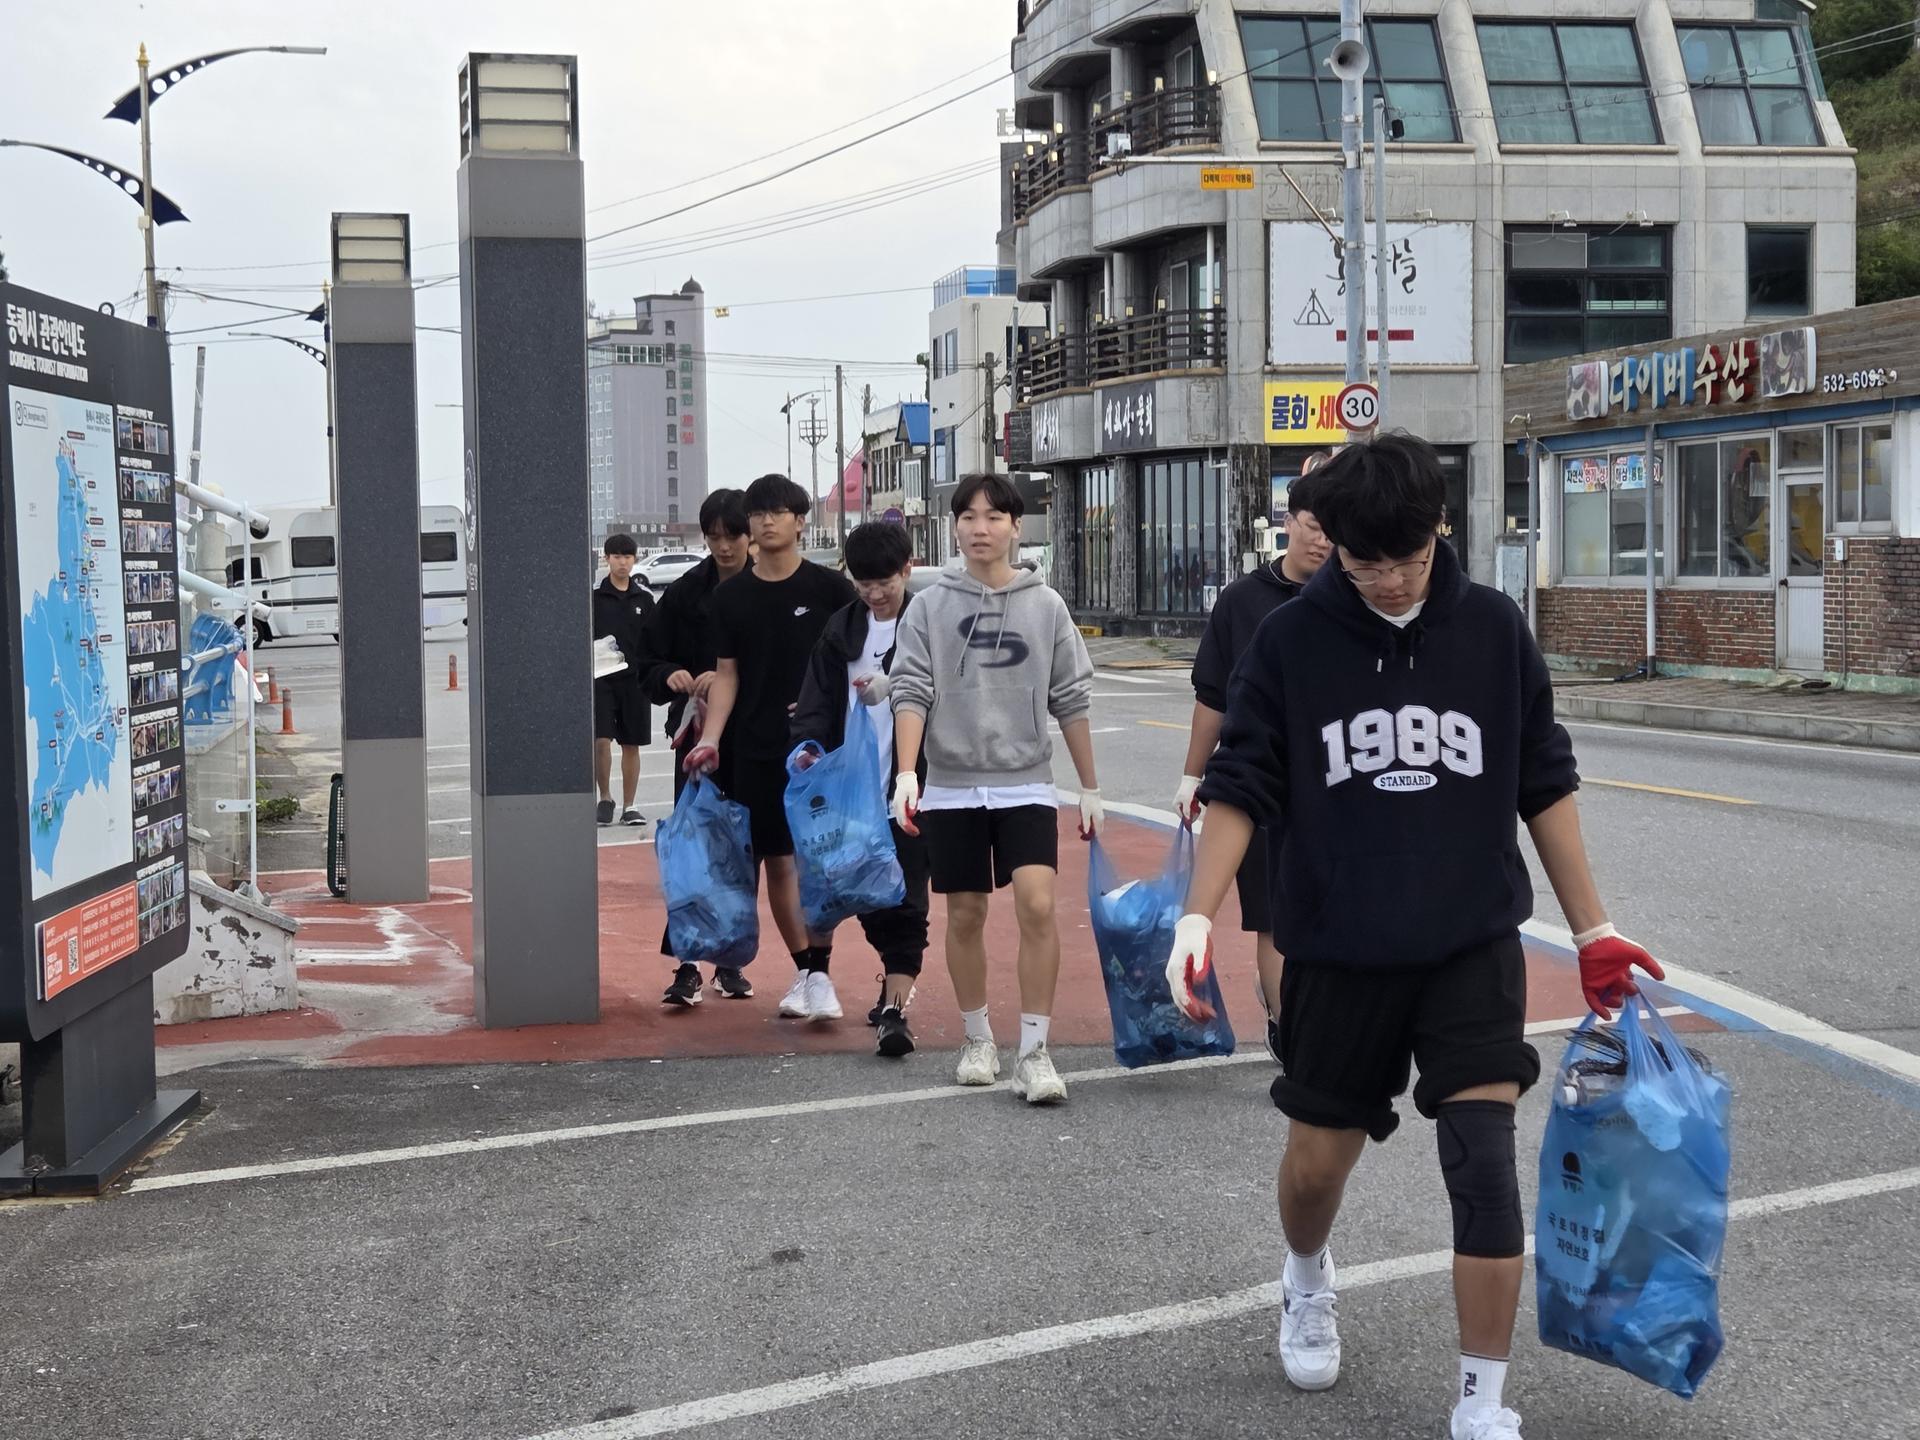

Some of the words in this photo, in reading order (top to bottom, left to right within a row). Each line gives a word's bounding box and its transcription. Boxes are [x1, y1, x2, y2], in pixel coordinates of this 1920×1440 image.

[6, 303, 38, 348] 동해시
[39, 313, 87, 358] 관광안내도
[36, 356, 57, 376] TOURIST
[1346, 397, 1374, 419] 30
[1321, 705, 1483, 788] 1989
[1380, 775, 1431, 787] STANDARD
[1557, 1237, 1590, 1262] 자연보호
[1464, 1372, 1477, 1398] FILA
